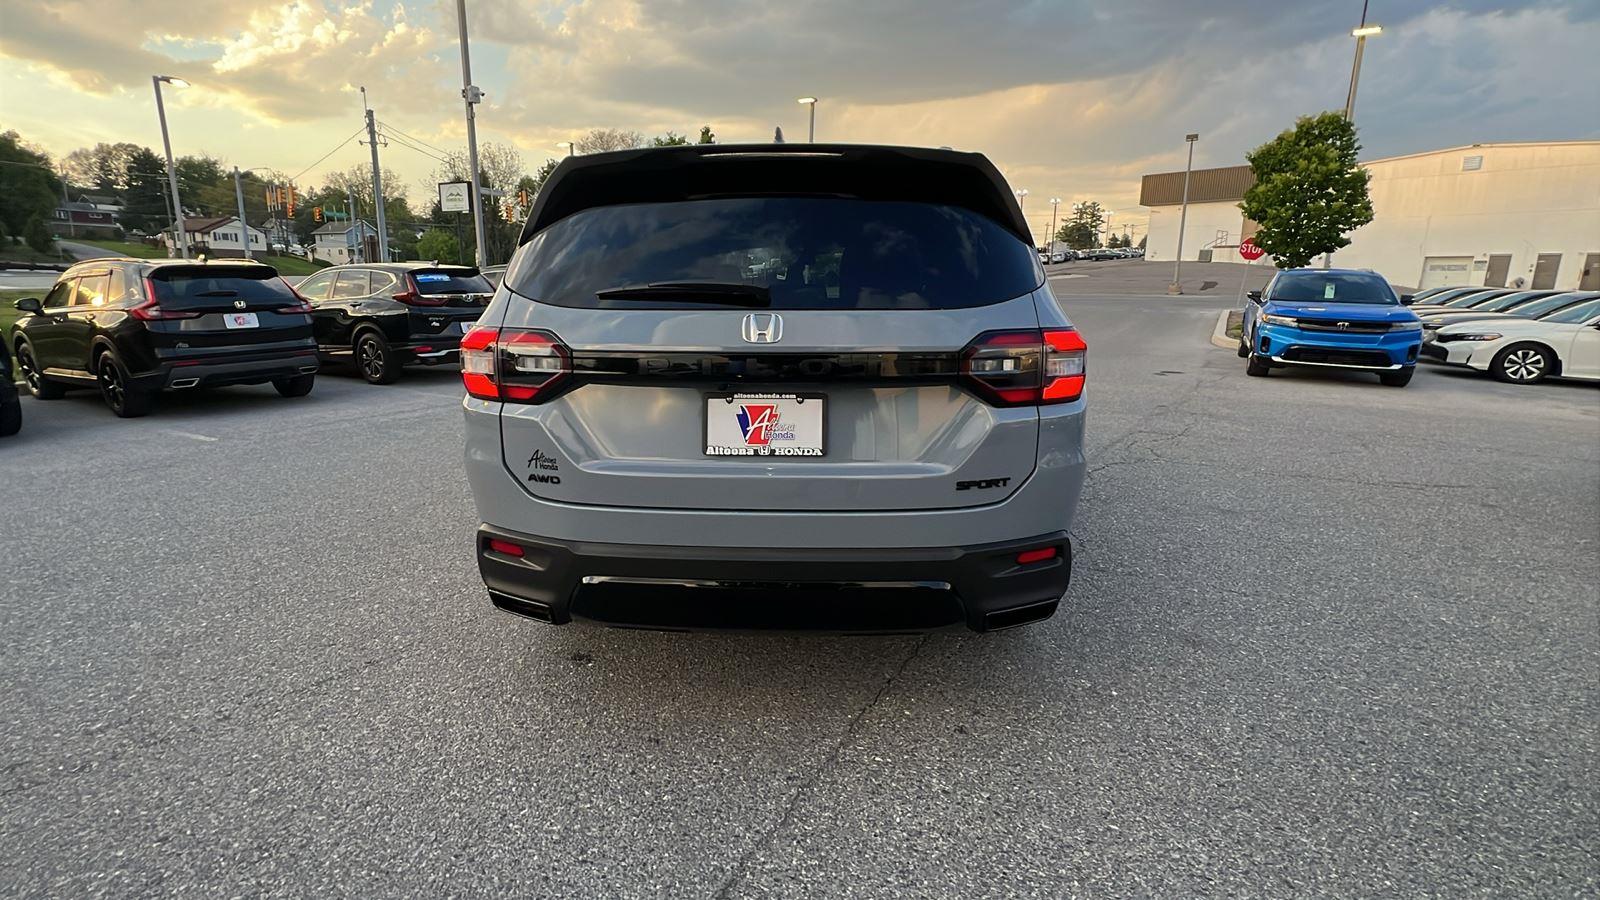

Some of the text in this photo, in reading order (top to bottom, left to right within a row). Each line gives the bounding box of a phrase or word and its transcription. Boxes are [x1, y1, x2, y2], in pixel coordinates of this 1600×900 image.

[765, 431, 795, 440] Honda
[706, 446, 755, 456] Altoona
[774, 447, 823, 456] HONDA
[527, 473, 561, 485] AWD
[955, 477, 1011, 491] SPORT
